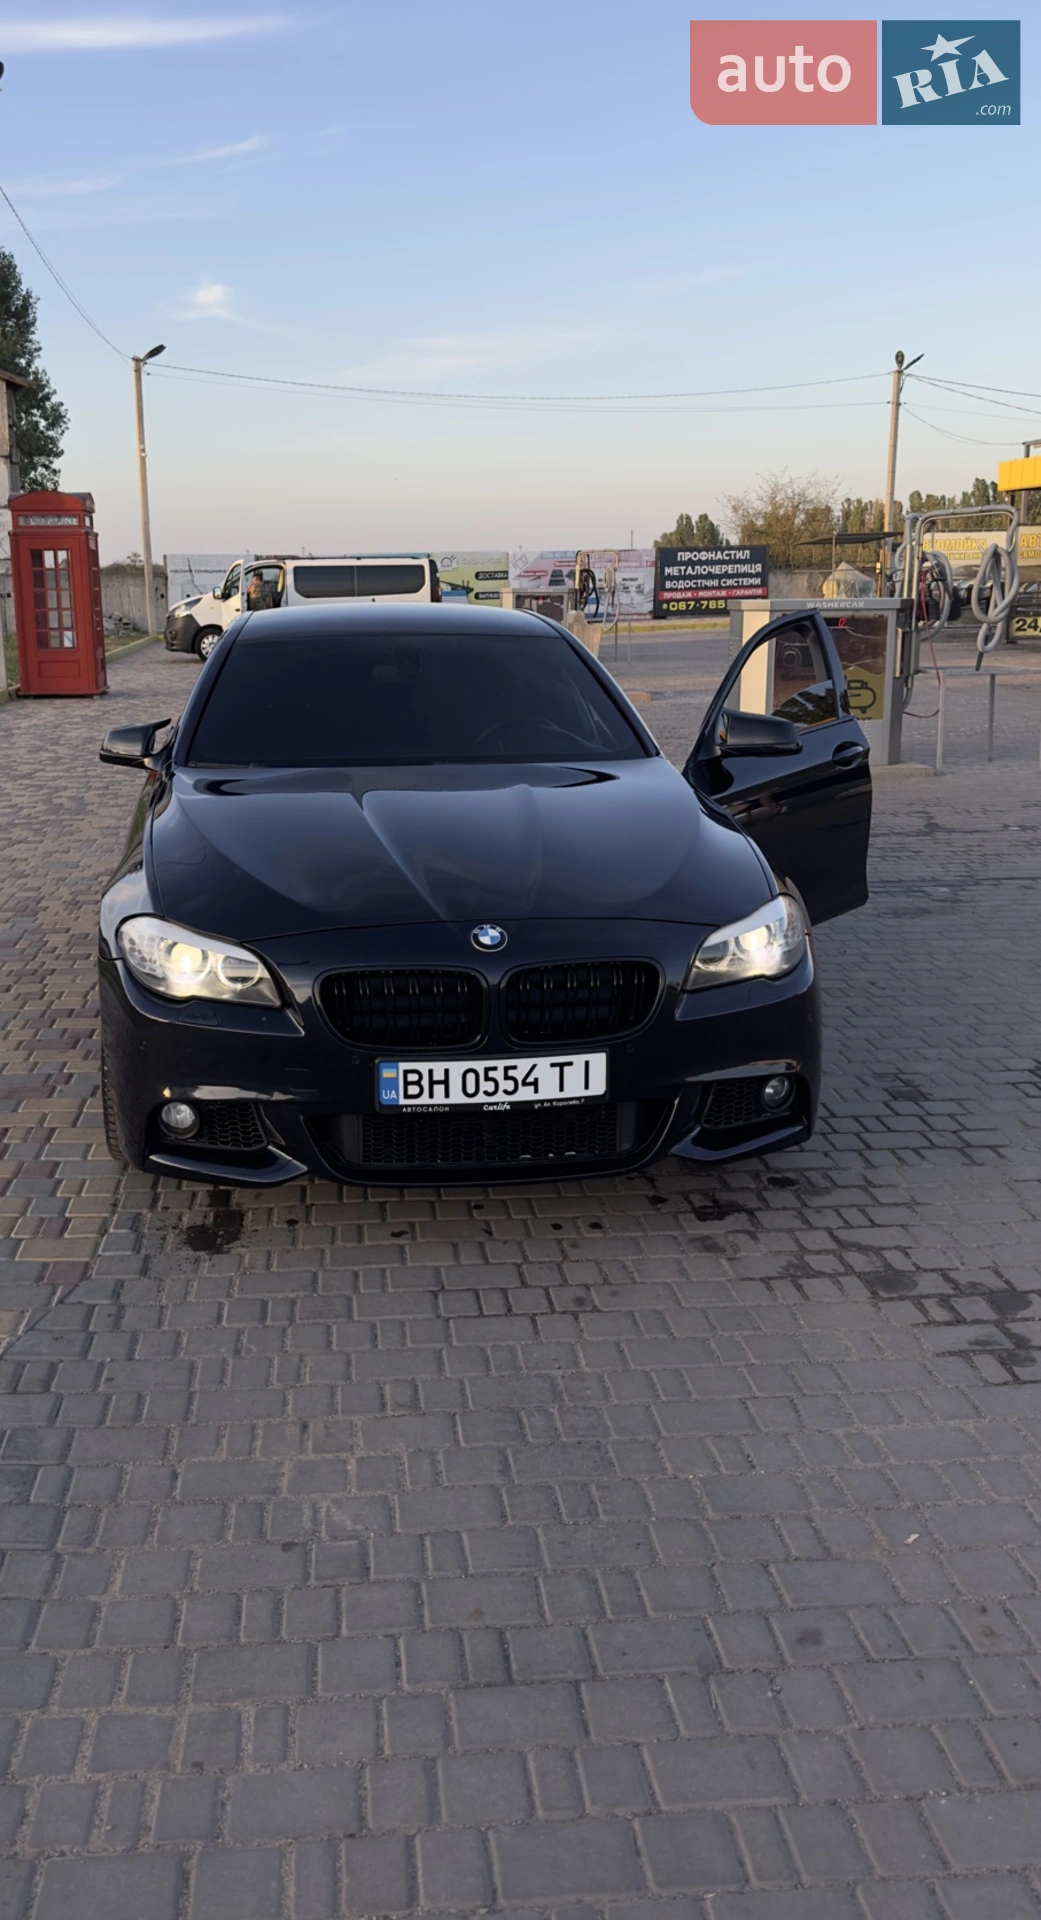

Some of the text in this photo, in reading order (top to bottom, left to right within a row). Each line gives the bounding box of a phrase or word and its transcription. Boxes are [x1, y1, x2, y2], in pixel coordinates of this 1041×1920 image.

[677, 550, 750, 561] ПРОФНАСТИЛ
[664, 563, 762, 576] МЕТАЛОЧЕРЕПИЦЯ
[478, 572, 508, 580] ДОСТАВКА
[665, 577, 762, 589] ВОДОСТІЧНІ СИСТЕМИ
[663, 588, 763, 599] ПРОДАЖ МОНТАЖ ГАРАНТІЯ
[806, 601, 865, 609] WASHERCAR
[402, 1068, 450, 1100] BH
[461, 1063, 540, 1099] 0554
[382, 1090, 398, 1100] UA
[483, 1102, 511, 1112] Carlife
